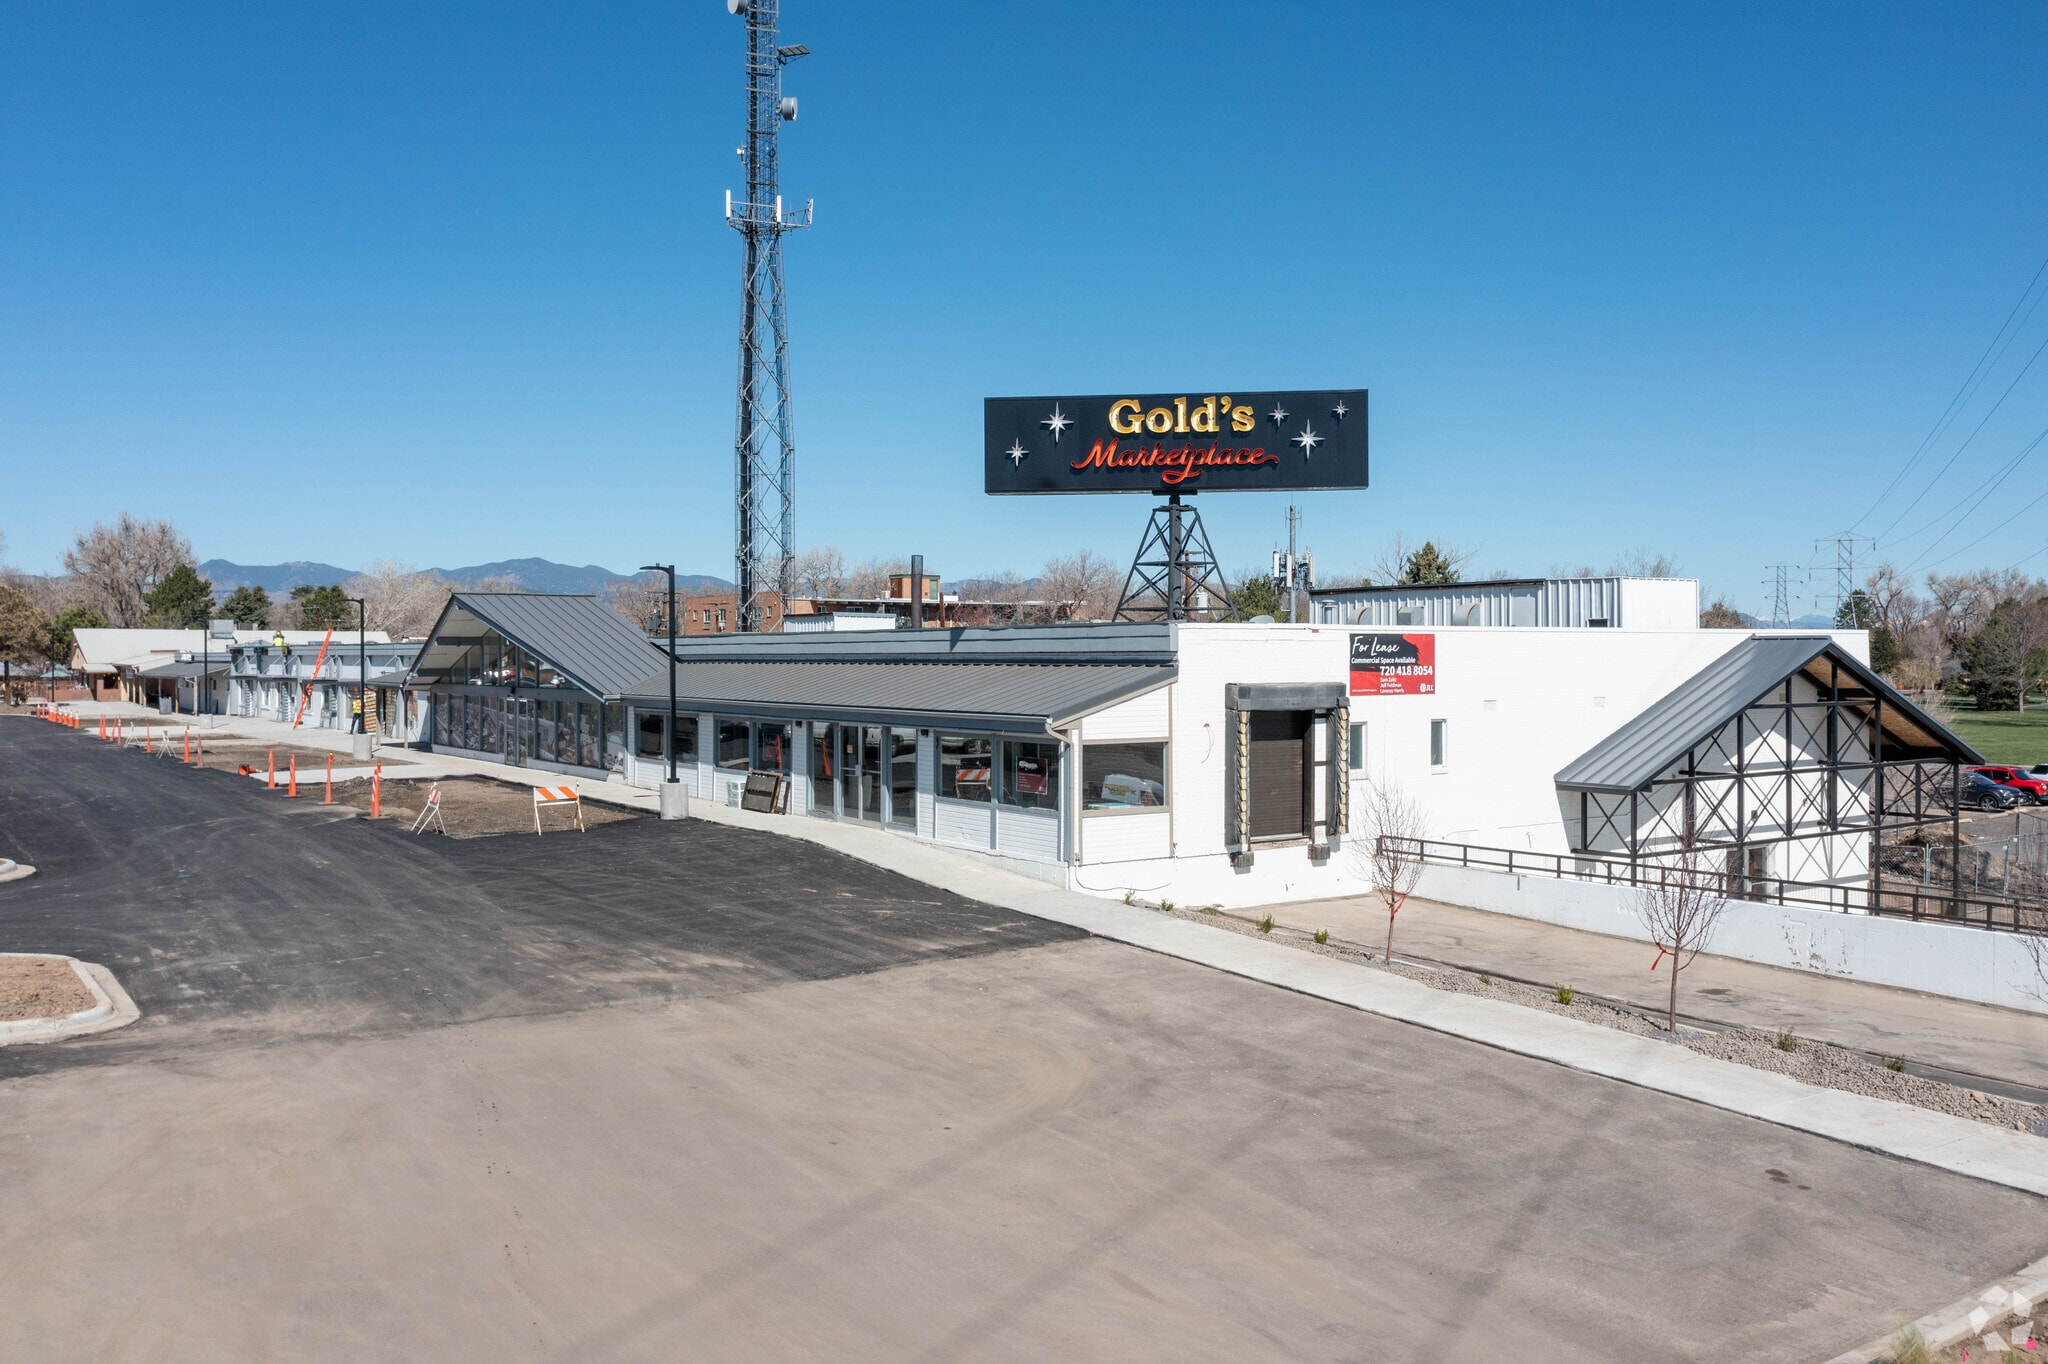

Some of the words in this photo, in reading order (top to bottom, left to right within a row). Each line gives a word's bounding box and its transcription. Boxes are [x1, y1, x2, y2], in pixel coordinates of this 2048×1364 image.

[1108, 396, 1255, 435] Gold's
[1071, 437, 1280, 485] Marketplace
[1352, 635, 1369, 655] For
[1370, 636, 1400, 656] Lease
[1380, 657, 1394, 665] Space
[1394, 656, 1416, 664] Available
[1380, 665, 1395, 676] 720
[1396, 665, 1412, 676] 418
[1413, 665, 1433, 675] 8054
